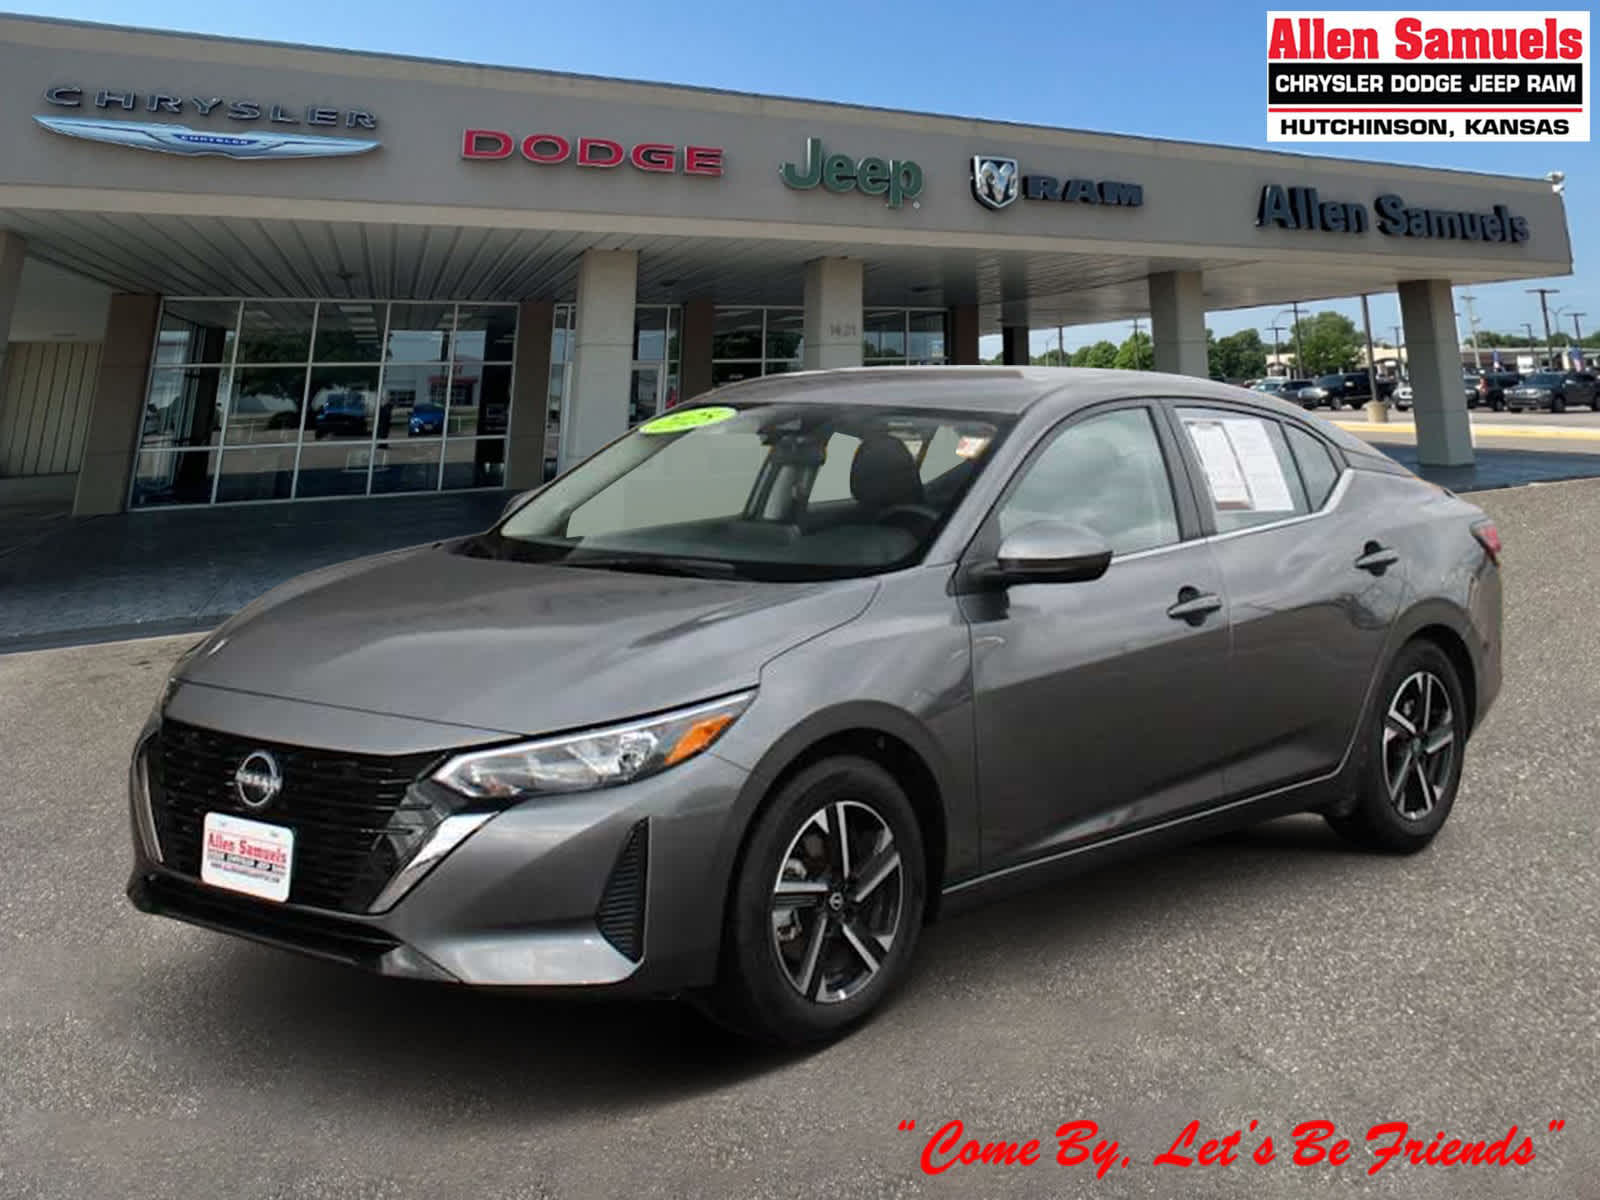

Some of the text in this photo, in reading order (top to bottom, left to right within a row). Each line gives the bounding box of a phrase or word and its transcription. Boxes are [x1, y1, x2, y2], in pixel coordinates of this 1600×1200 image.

[45, 87, 378, 129] CHRYSLER
[461, 128, 724, 176] DODGE
[778, 136, 923, 208] Jeep
[1023, 175, 1143, 207] RAM
[1256, 184, 1530, 243] Allen Samuels
